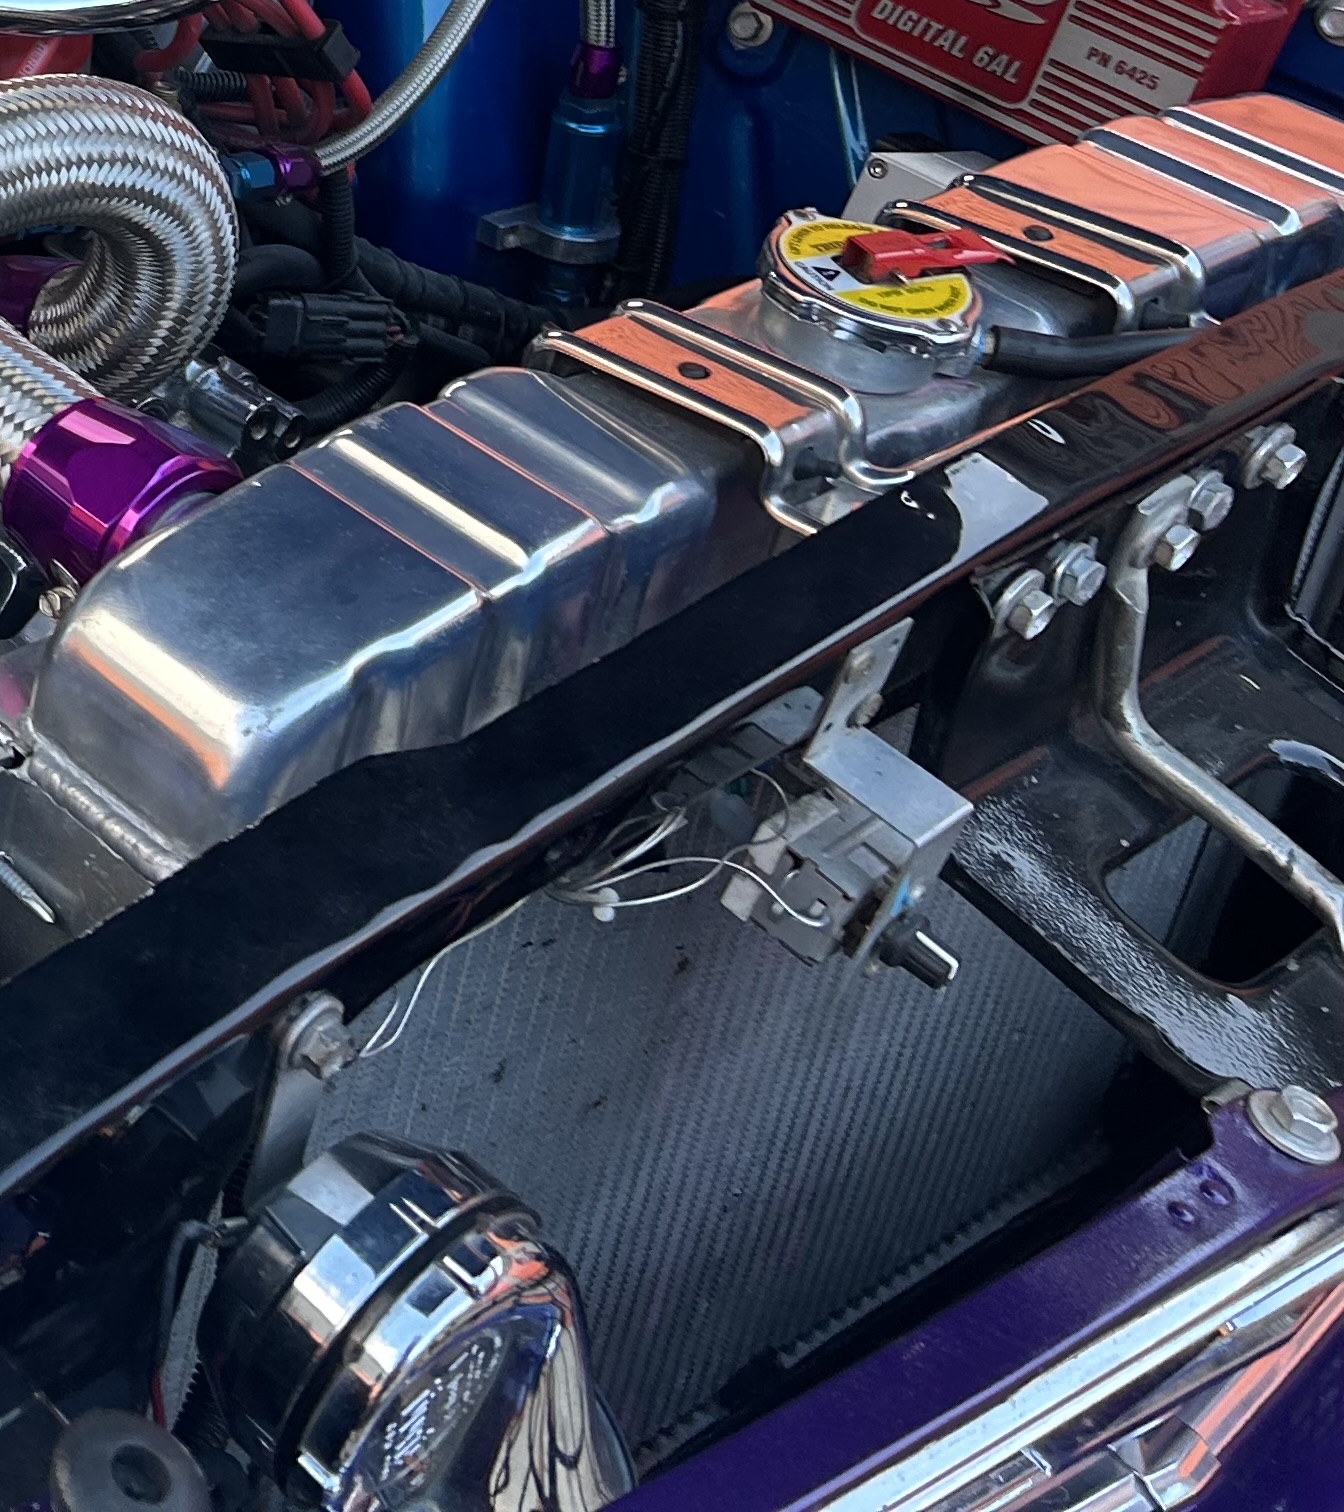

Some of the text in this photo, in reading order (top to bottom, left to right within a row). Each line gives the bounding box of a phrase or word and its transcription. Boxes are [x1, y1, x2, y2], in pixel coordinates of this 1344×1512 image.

[971, 44, 1026, 85] 6AL
[1085, 46, 1161, 91] PN 6425
